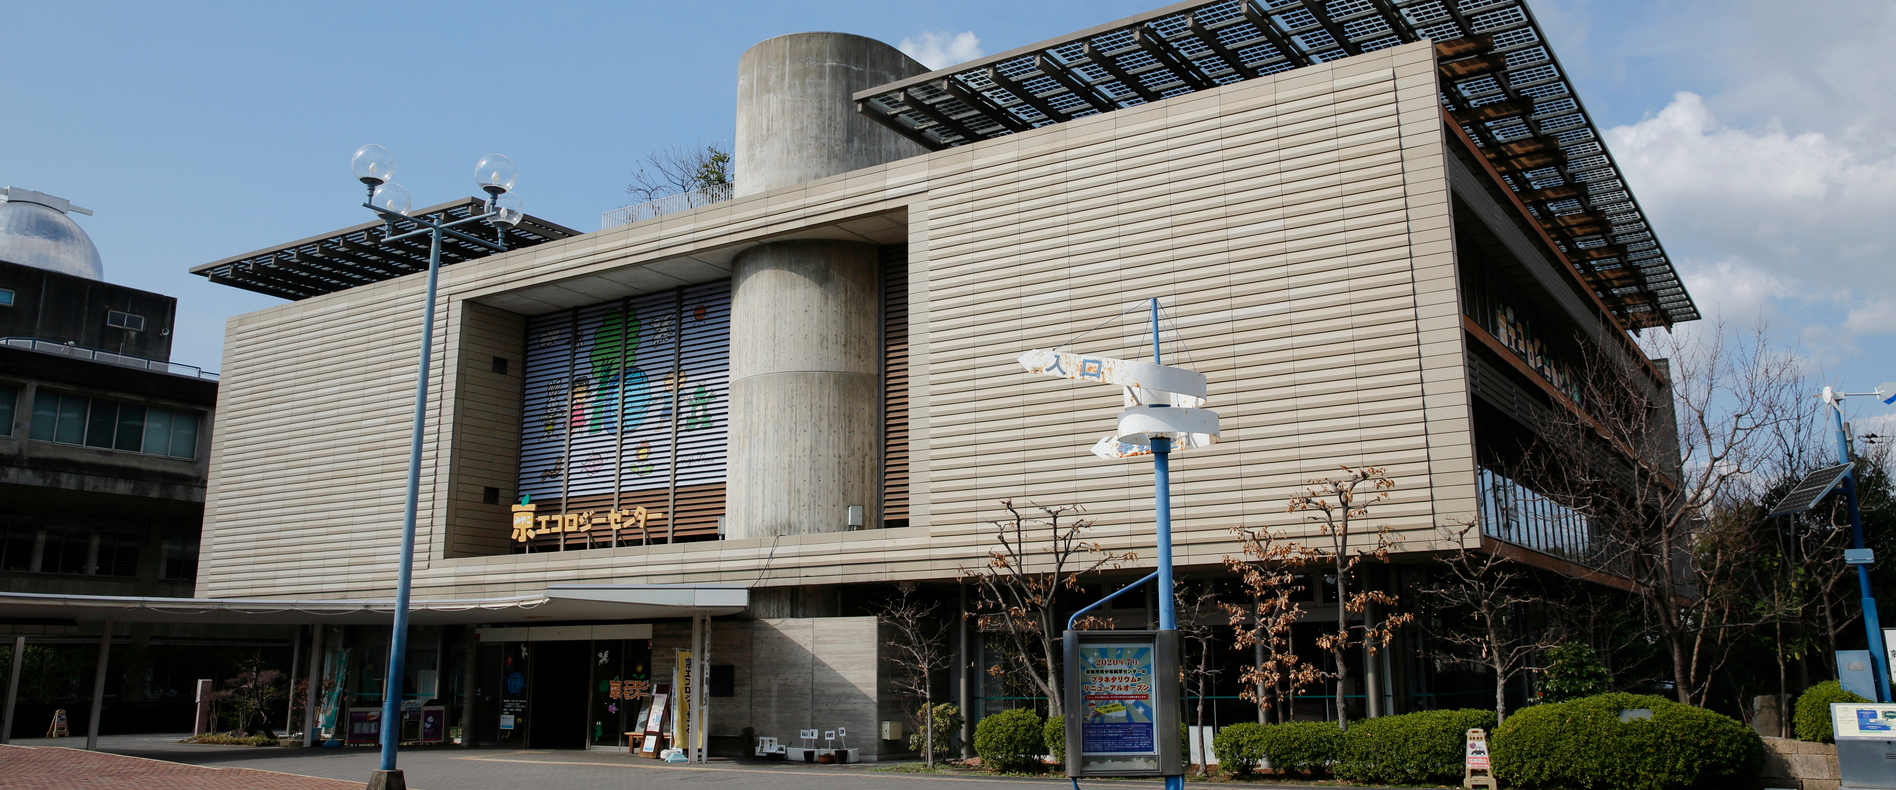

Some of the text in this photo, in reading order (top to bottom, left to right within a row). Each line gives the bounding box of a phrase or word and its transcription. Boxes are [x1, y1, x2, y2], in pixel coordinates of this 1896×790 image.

[1045, 354, 1103, 379] 入口
[511, 503, 664, 543] 京エコロジーセンター
